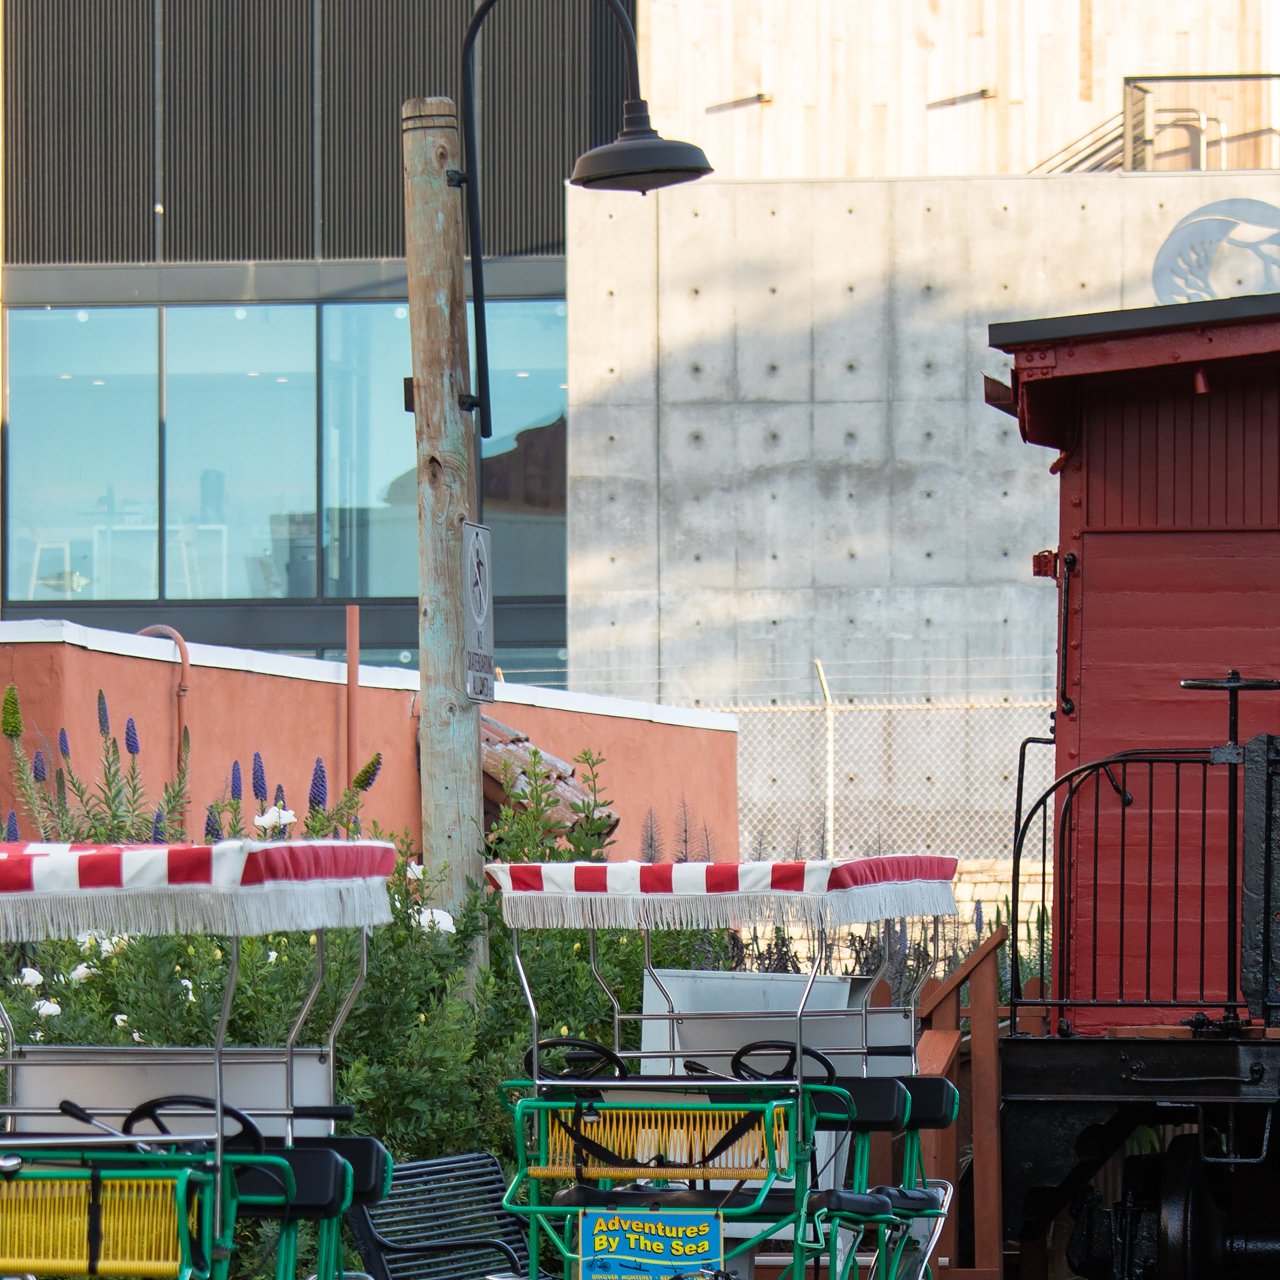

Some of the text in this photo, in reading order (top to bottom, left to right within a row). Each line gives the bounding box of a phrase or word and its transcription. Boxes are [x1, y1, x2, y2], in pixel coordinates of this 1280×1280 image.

[593, 1216, 710, 1239] Adventures
[594, 1233, 710, 1256] By The Sea
